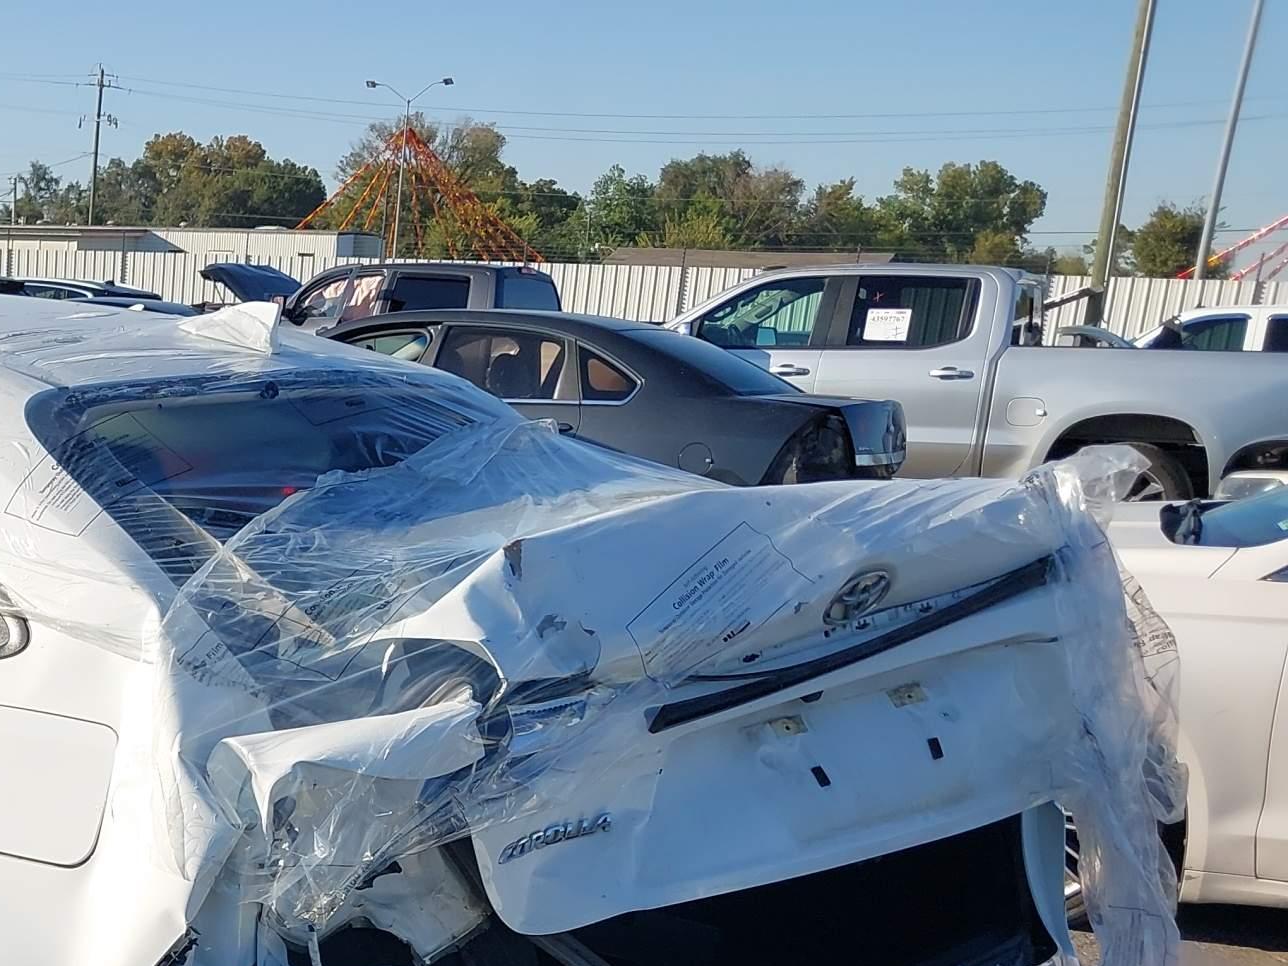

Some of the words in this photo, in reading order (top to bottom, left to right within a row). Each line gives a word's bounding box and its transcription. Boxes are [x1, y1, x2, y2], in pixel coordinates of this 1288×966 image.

[672, 586, 700, 610] Collision
[697, 571, 715, 587] Wrap
[714, 557, 730, 572] Film
[205, 641, 224, 660] Film
